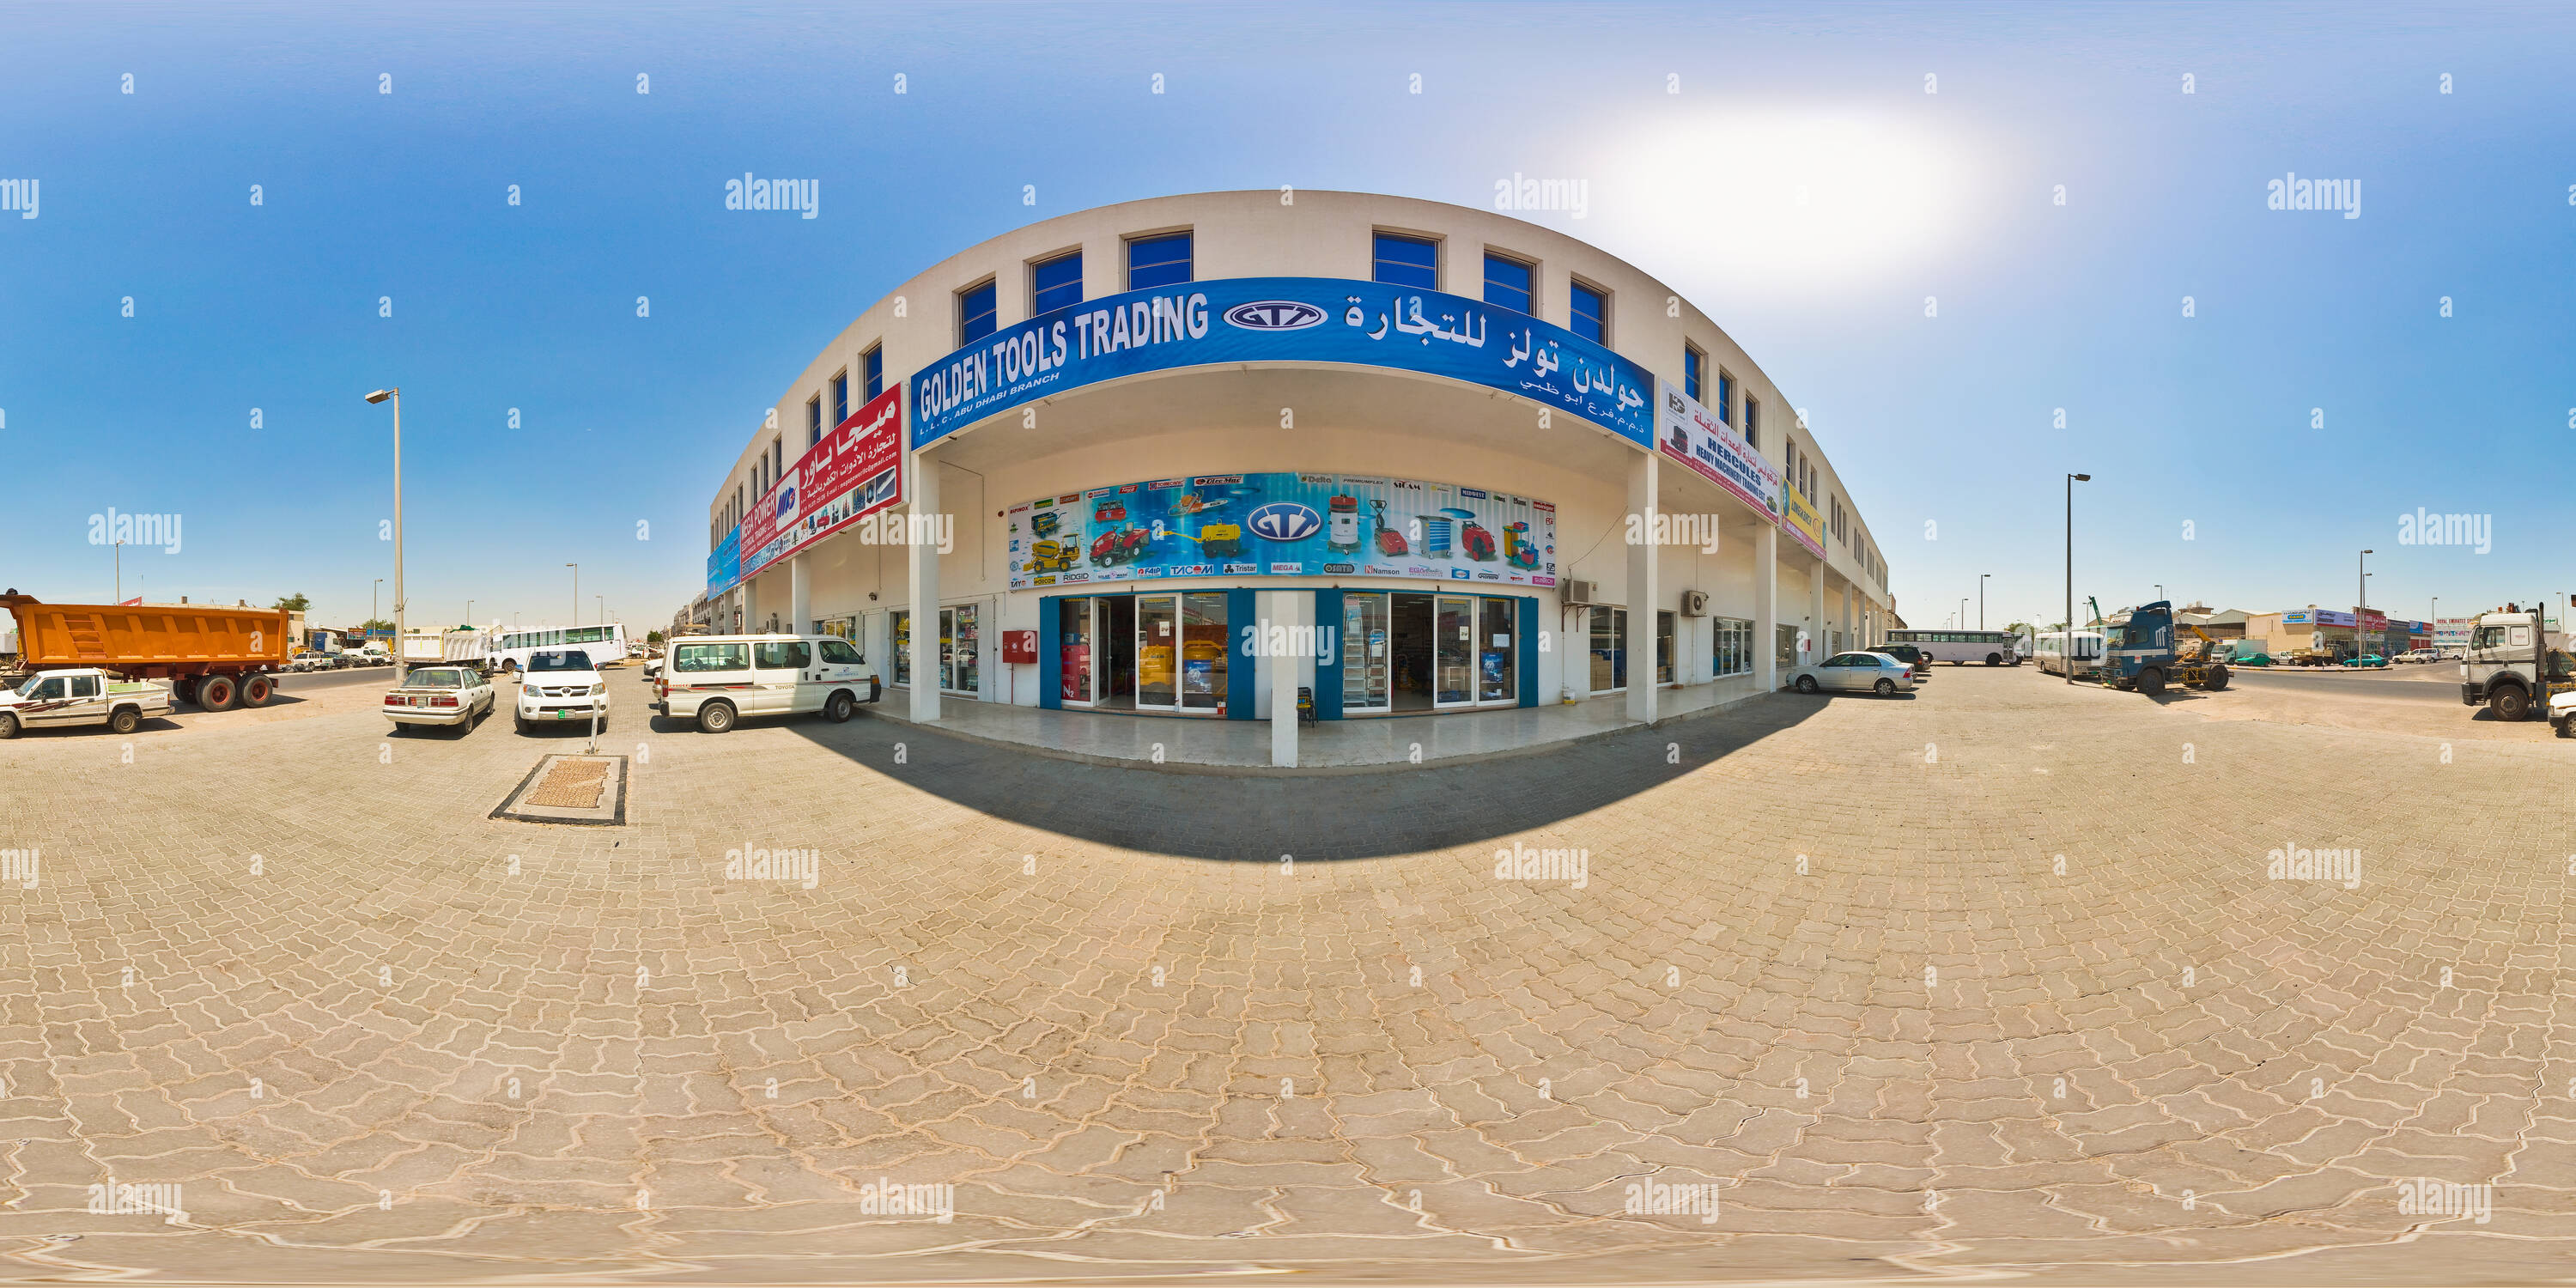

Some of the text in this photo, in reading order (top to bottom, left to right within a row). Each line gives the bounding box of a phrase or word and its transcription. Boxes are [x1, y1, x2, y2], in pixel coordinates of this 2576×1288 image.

[920, 293, 1208, 422] GOLDEN TOOLS TRADING
[1344, 295, 1644, 419] جولدن تولز للتجارة
[954, 404, 974, 419] ABU
[975, 390, 1007, 410] DHABI
[1010, 372, 1060, 396] BRANCH
[801, 400, 896, 489] ميجا باور
[1697, 444, 1714, 465] HEAVY
[1715, 457, 1741, 484] MACHINERY
[1708, 436, 1761, 486] HERCULES
[754, 491, 775, 526] POWER
[1373, 566, 1400, 574] Namson
